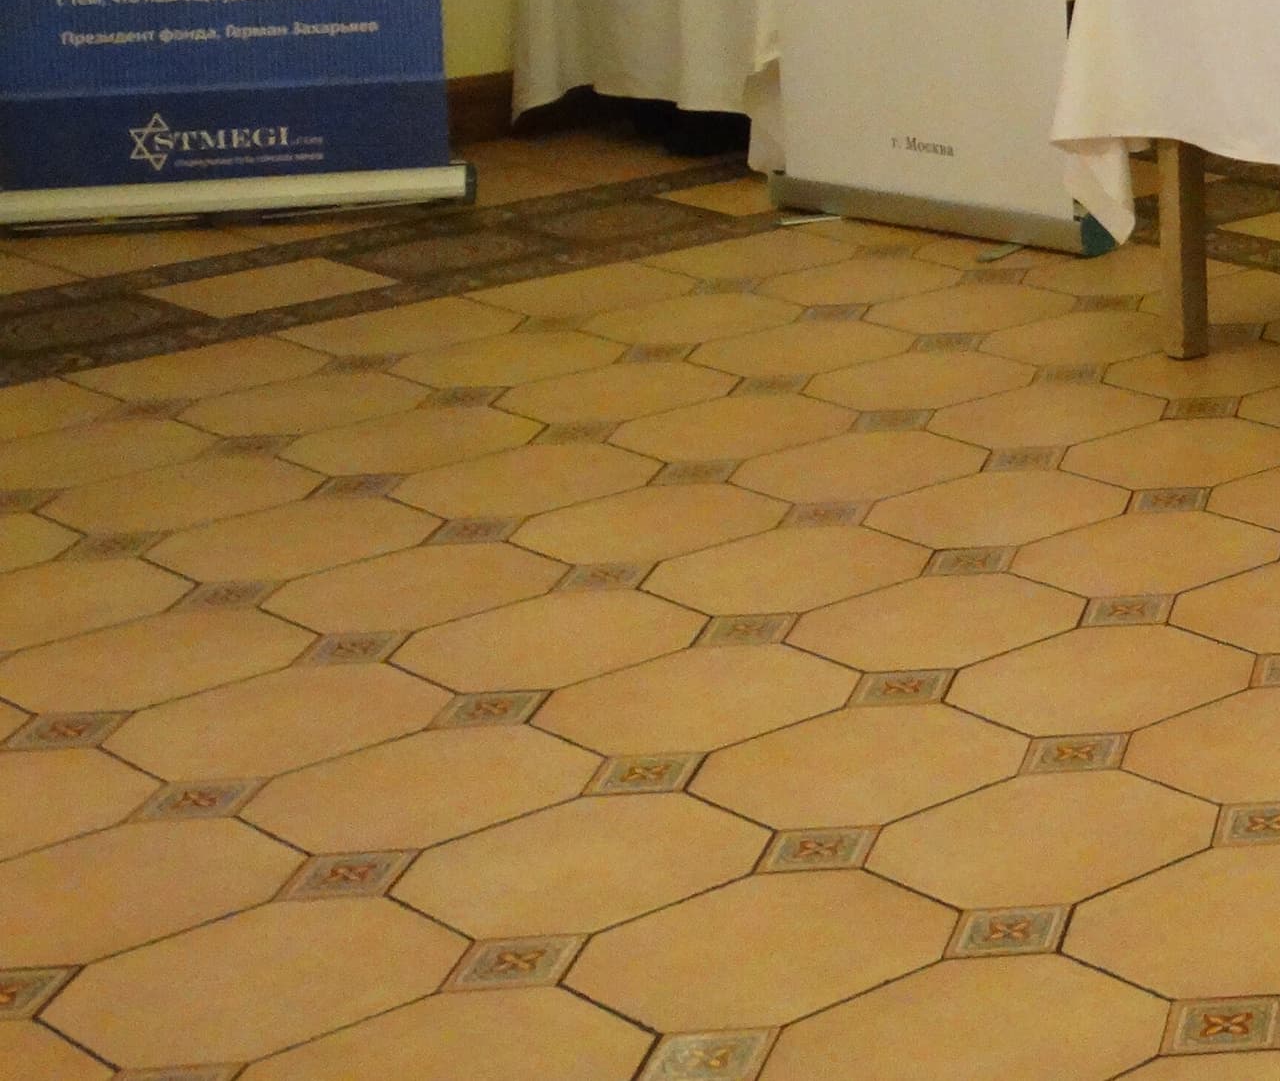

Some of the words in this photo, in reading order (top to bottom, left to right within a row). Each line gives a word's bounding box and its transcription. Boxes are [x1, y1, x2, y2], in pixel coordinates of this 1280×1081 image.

[60, 31, 155, 47] Президент
[226, 25, 287, 40] Герман
[905, 136, 954, 156] Москва
